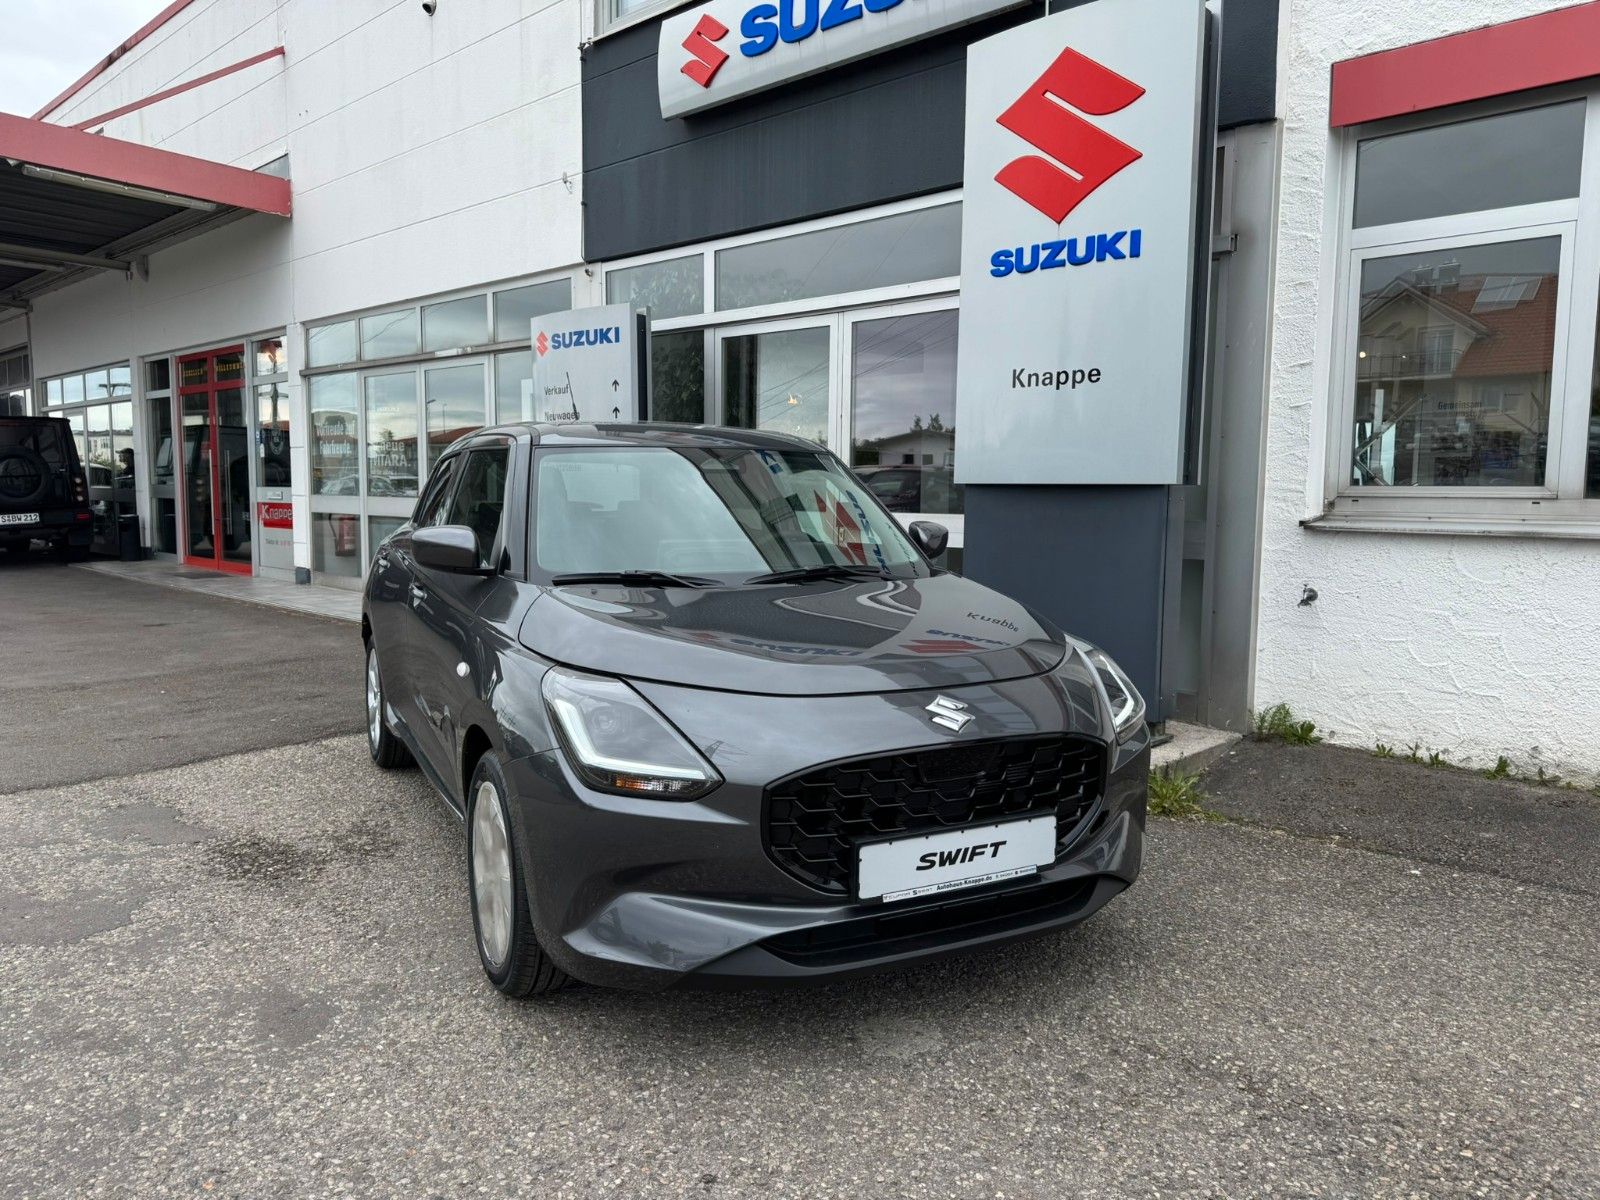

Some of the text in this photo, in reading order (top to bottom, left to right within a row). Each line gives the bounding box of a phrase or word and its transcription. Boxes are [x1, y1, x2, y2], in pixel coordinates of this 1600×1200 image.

[740, 0, 902, 57] SUZ
[990, 229, 1142, 278] SUZUKI
[551, 327, 620, 350] SUZUKI
[544, 384, 570, 396] Verkauf
[1012, 367, 1101, 390] Knappe
[262, 504, 292, 520] Knappe
[916, 840, 1007, 871] SWIFT
